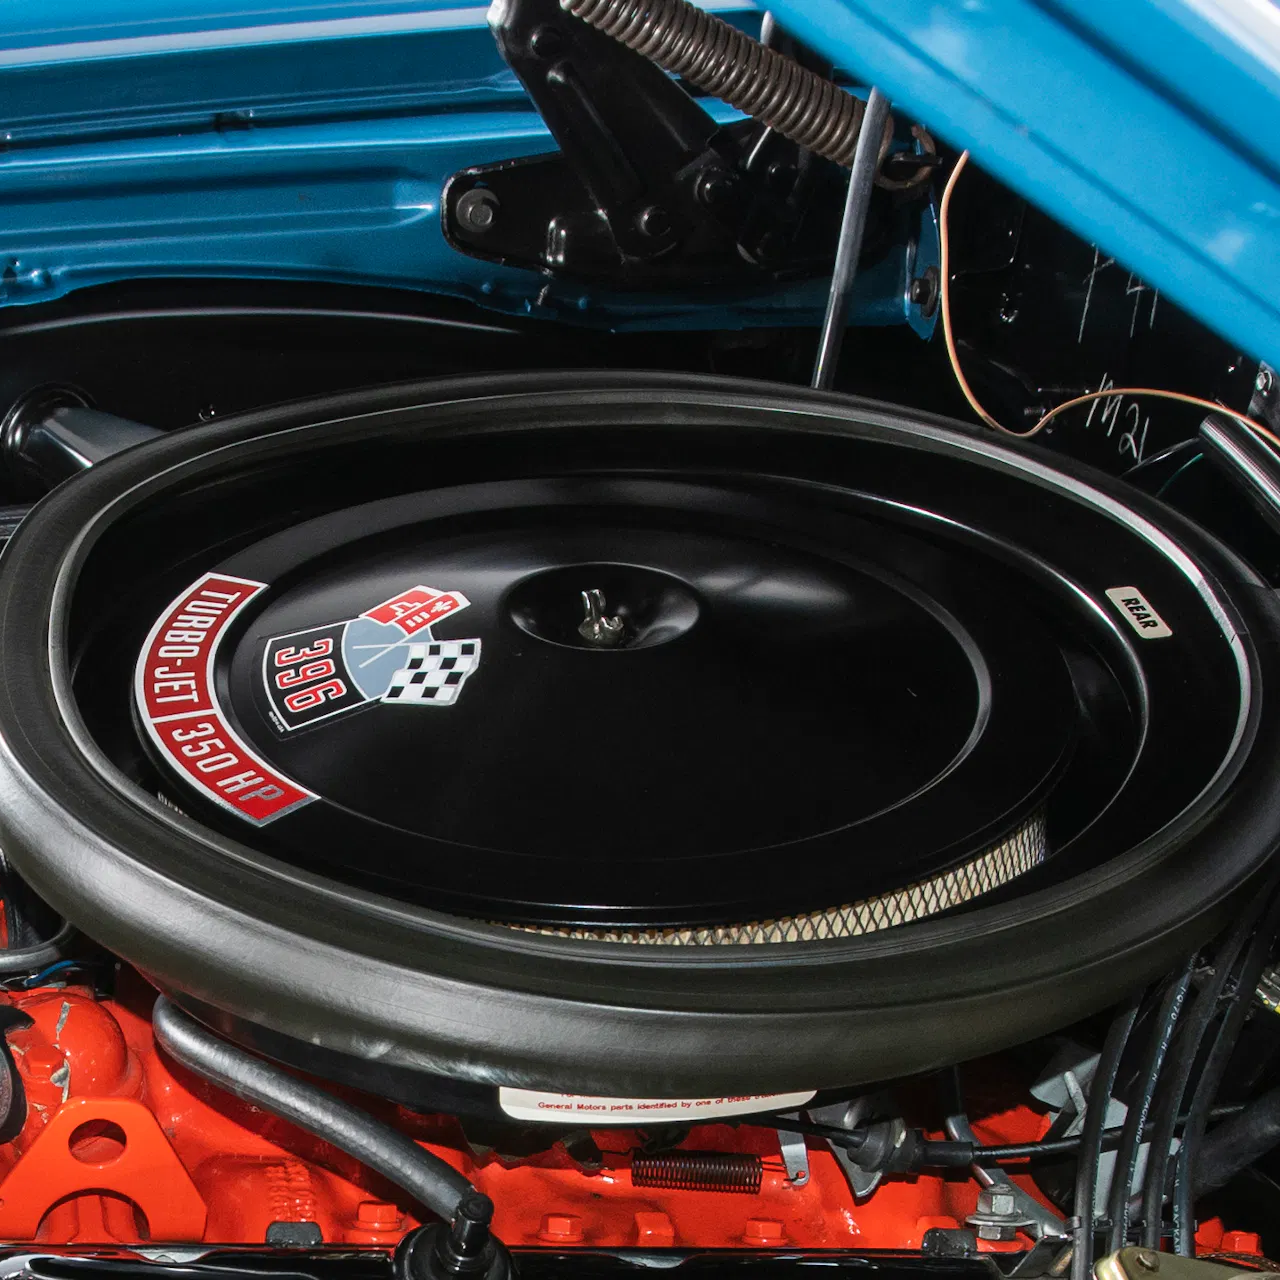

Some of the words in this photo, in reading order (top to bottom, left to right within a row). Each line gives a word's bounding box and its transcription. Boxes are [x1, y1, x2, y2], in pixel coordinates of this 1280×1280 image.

[1121, 597, 1159, 630] REAR
[153, 588, 242, 706] TURBO-JET
[274, 637, 348, 714] 396
[171, 722, 240, 774] 350
[223, 769, 286, 805] HP
[537, 1101, 573, 1111] General
[576, 1102, 607, 1111] Motors
[610, 1103, 633, 1112] parts
[637, 1101, 678, 1110] identified
[681, 1100, 692, 1110] by
[715, 1097, 724, 1105] of
[1136, 1094, 1153, 1144] PACKARD
